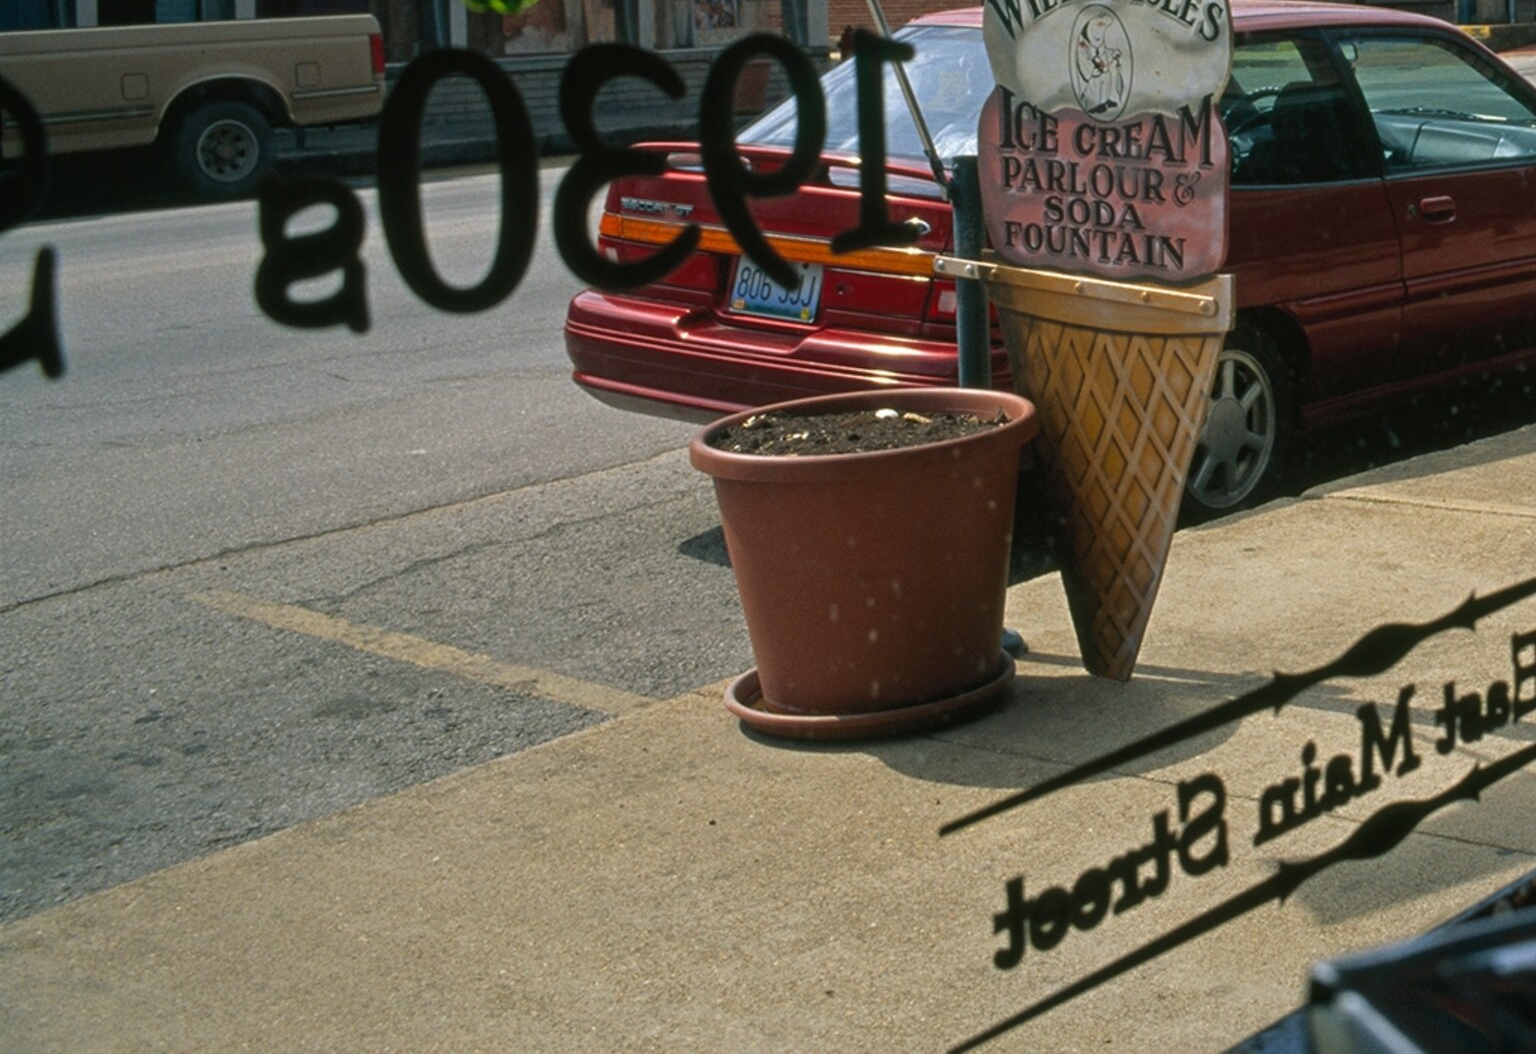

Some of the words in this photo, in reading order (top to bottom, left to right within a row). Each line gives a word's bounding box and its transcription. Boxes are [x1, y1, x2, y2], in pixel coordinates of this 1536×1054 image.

[997, 84, 1060, 156] ICE
[1074, 93, 1217, 171] CREAM
[1000, 156, 1168, 204] PARLOUR
[1174, 171, 1202, 207] &
[1043, 196, 1146, 231] SODA
[1005, 221, 1188, 271] FOUNTAIN
[737, 266, 772, 301] 806
